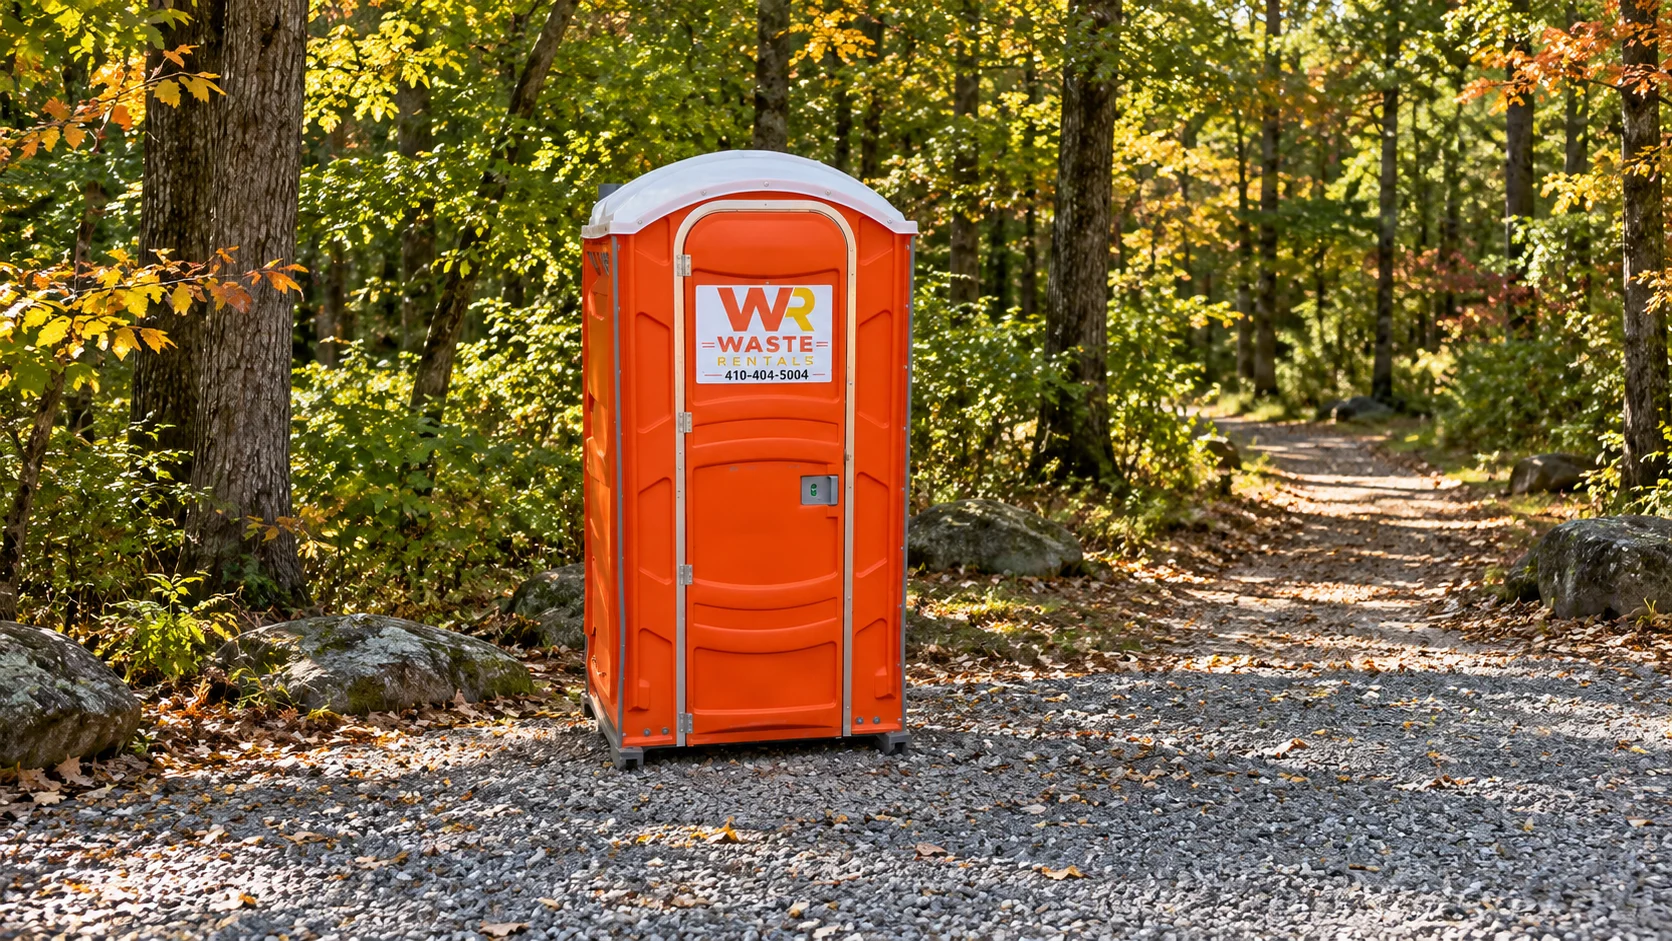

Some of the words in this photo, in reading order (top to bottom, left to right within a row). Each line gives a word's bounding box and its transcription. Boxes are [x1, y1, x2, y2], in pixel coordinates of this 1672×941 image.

[717, 287, 816, 332] WR
[717, 335, 813, 353] WASTE
[717, 355, 814, 367] RENTALS
[724, 369, 809, 381] 410-404-5004
